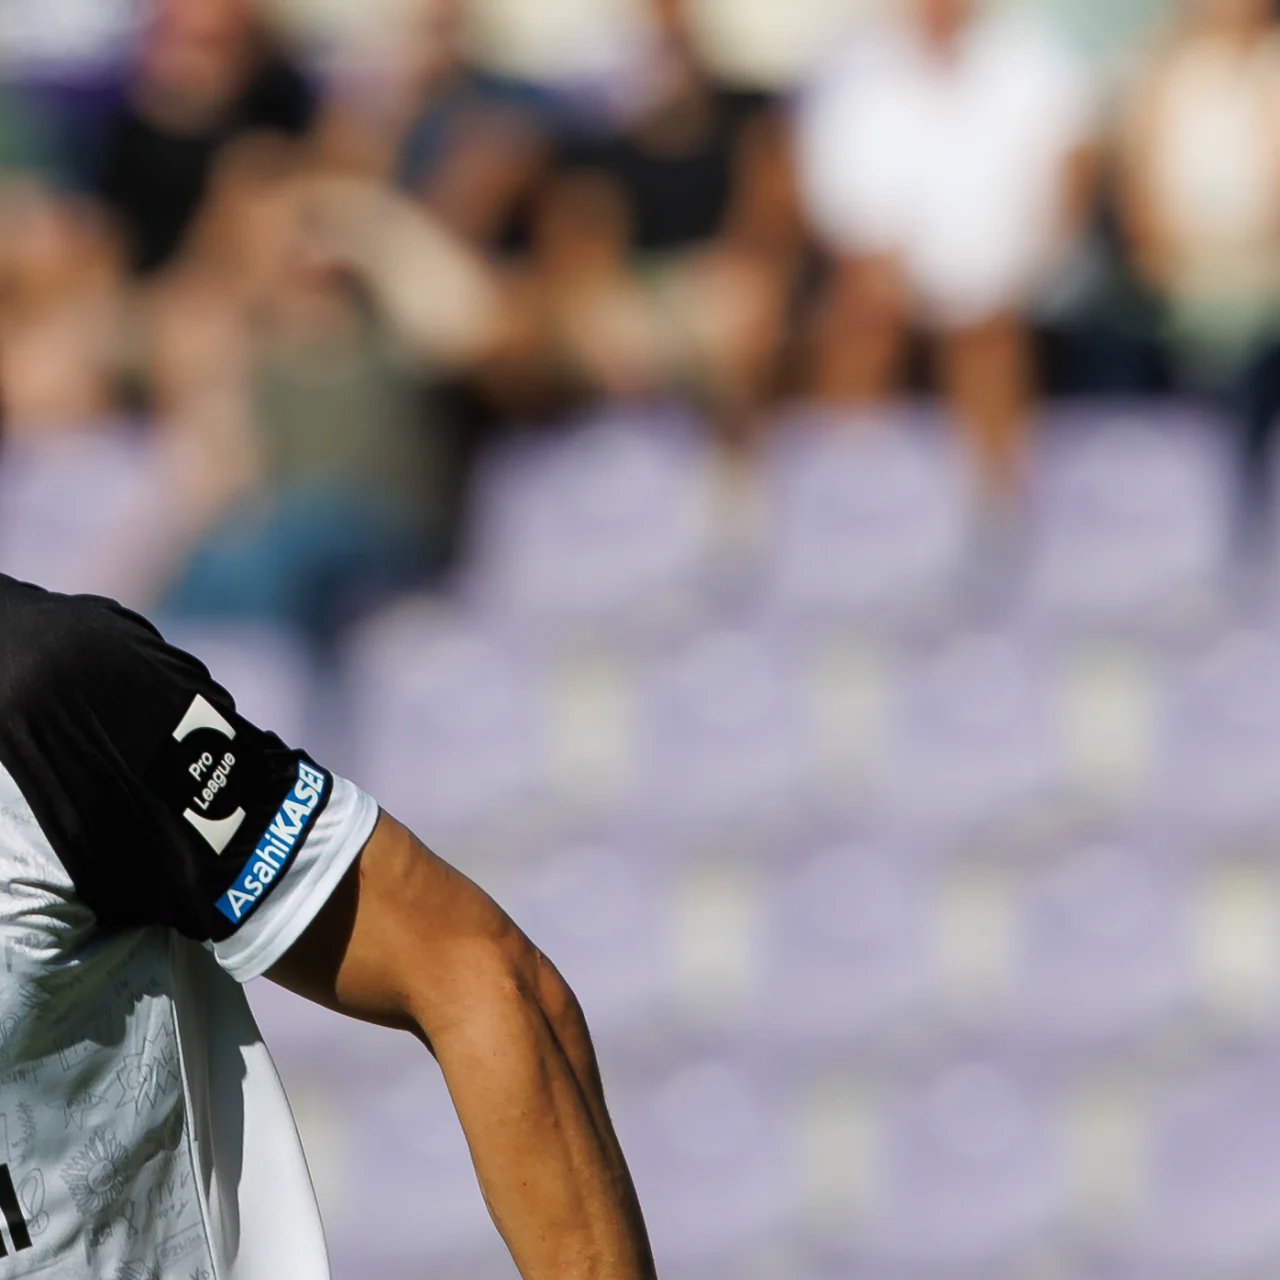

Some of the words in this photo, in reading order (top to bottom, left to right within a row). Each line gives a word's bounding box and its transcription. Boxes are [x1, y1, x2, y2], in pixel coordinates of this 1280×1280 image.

[187, 751, 214, 782] Pro
[193, 752, 236, 811] League
[226, 763, 325, 918] AsahiKASEI
